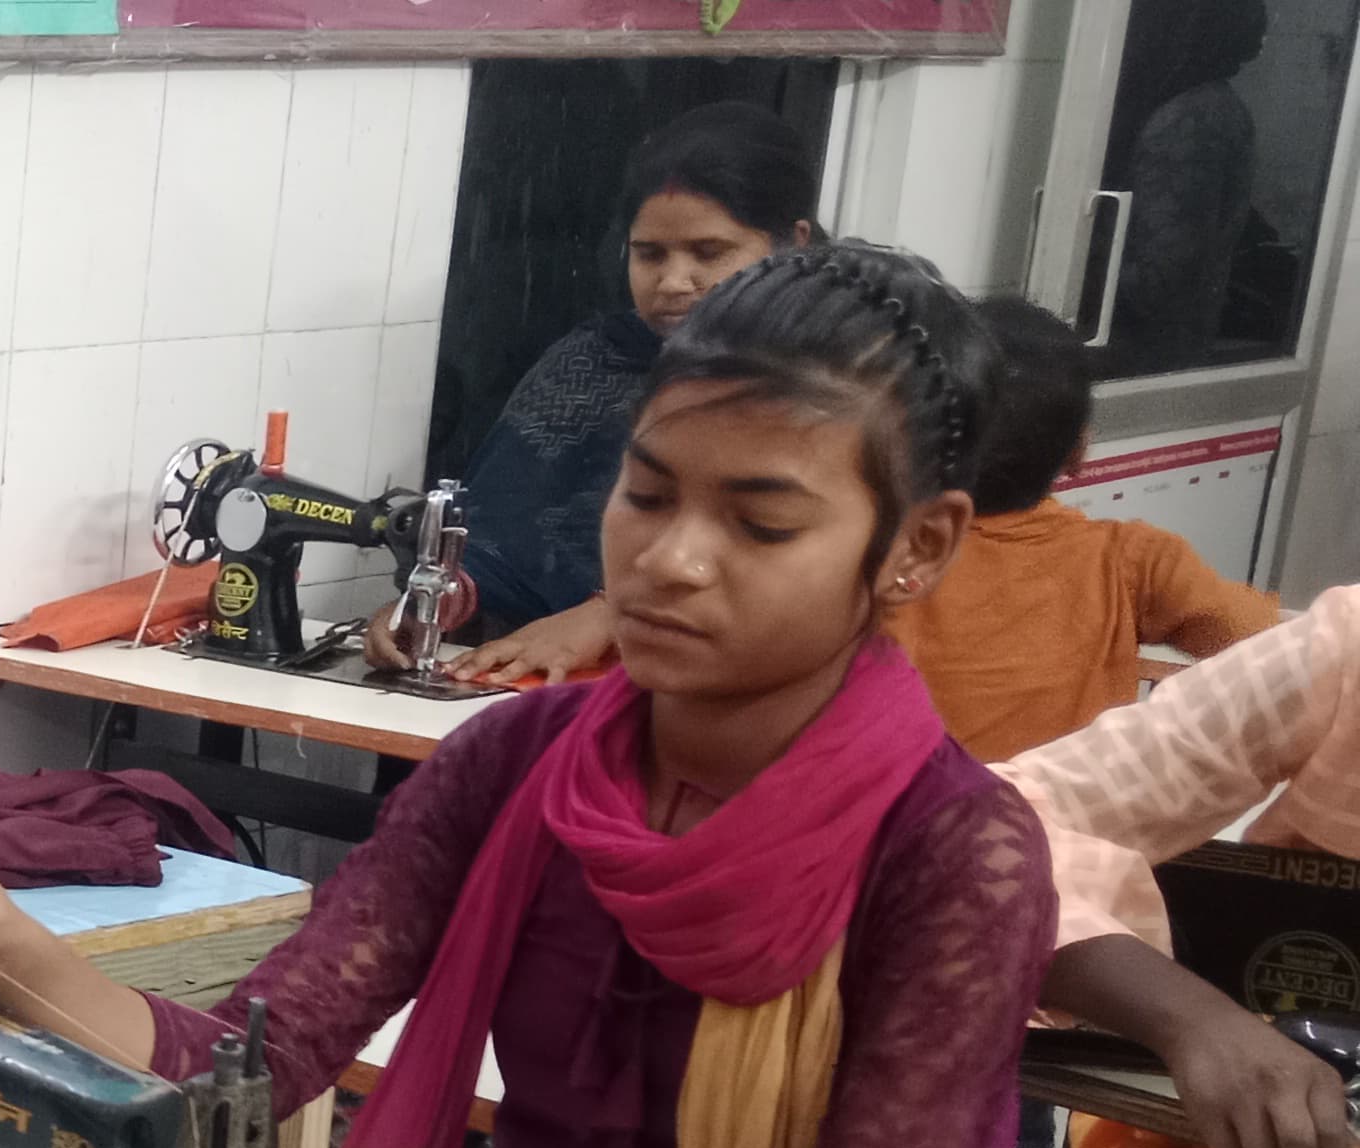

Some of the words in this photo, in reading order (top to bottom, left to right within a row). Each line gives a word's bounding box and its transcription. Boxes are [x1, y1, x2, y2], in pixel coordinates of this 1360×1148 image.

[294, 498, 357, 526] DECEN
[1274, 854, 1360, 891] ECENT
[1262, 966, 1350, 998] DECENT
